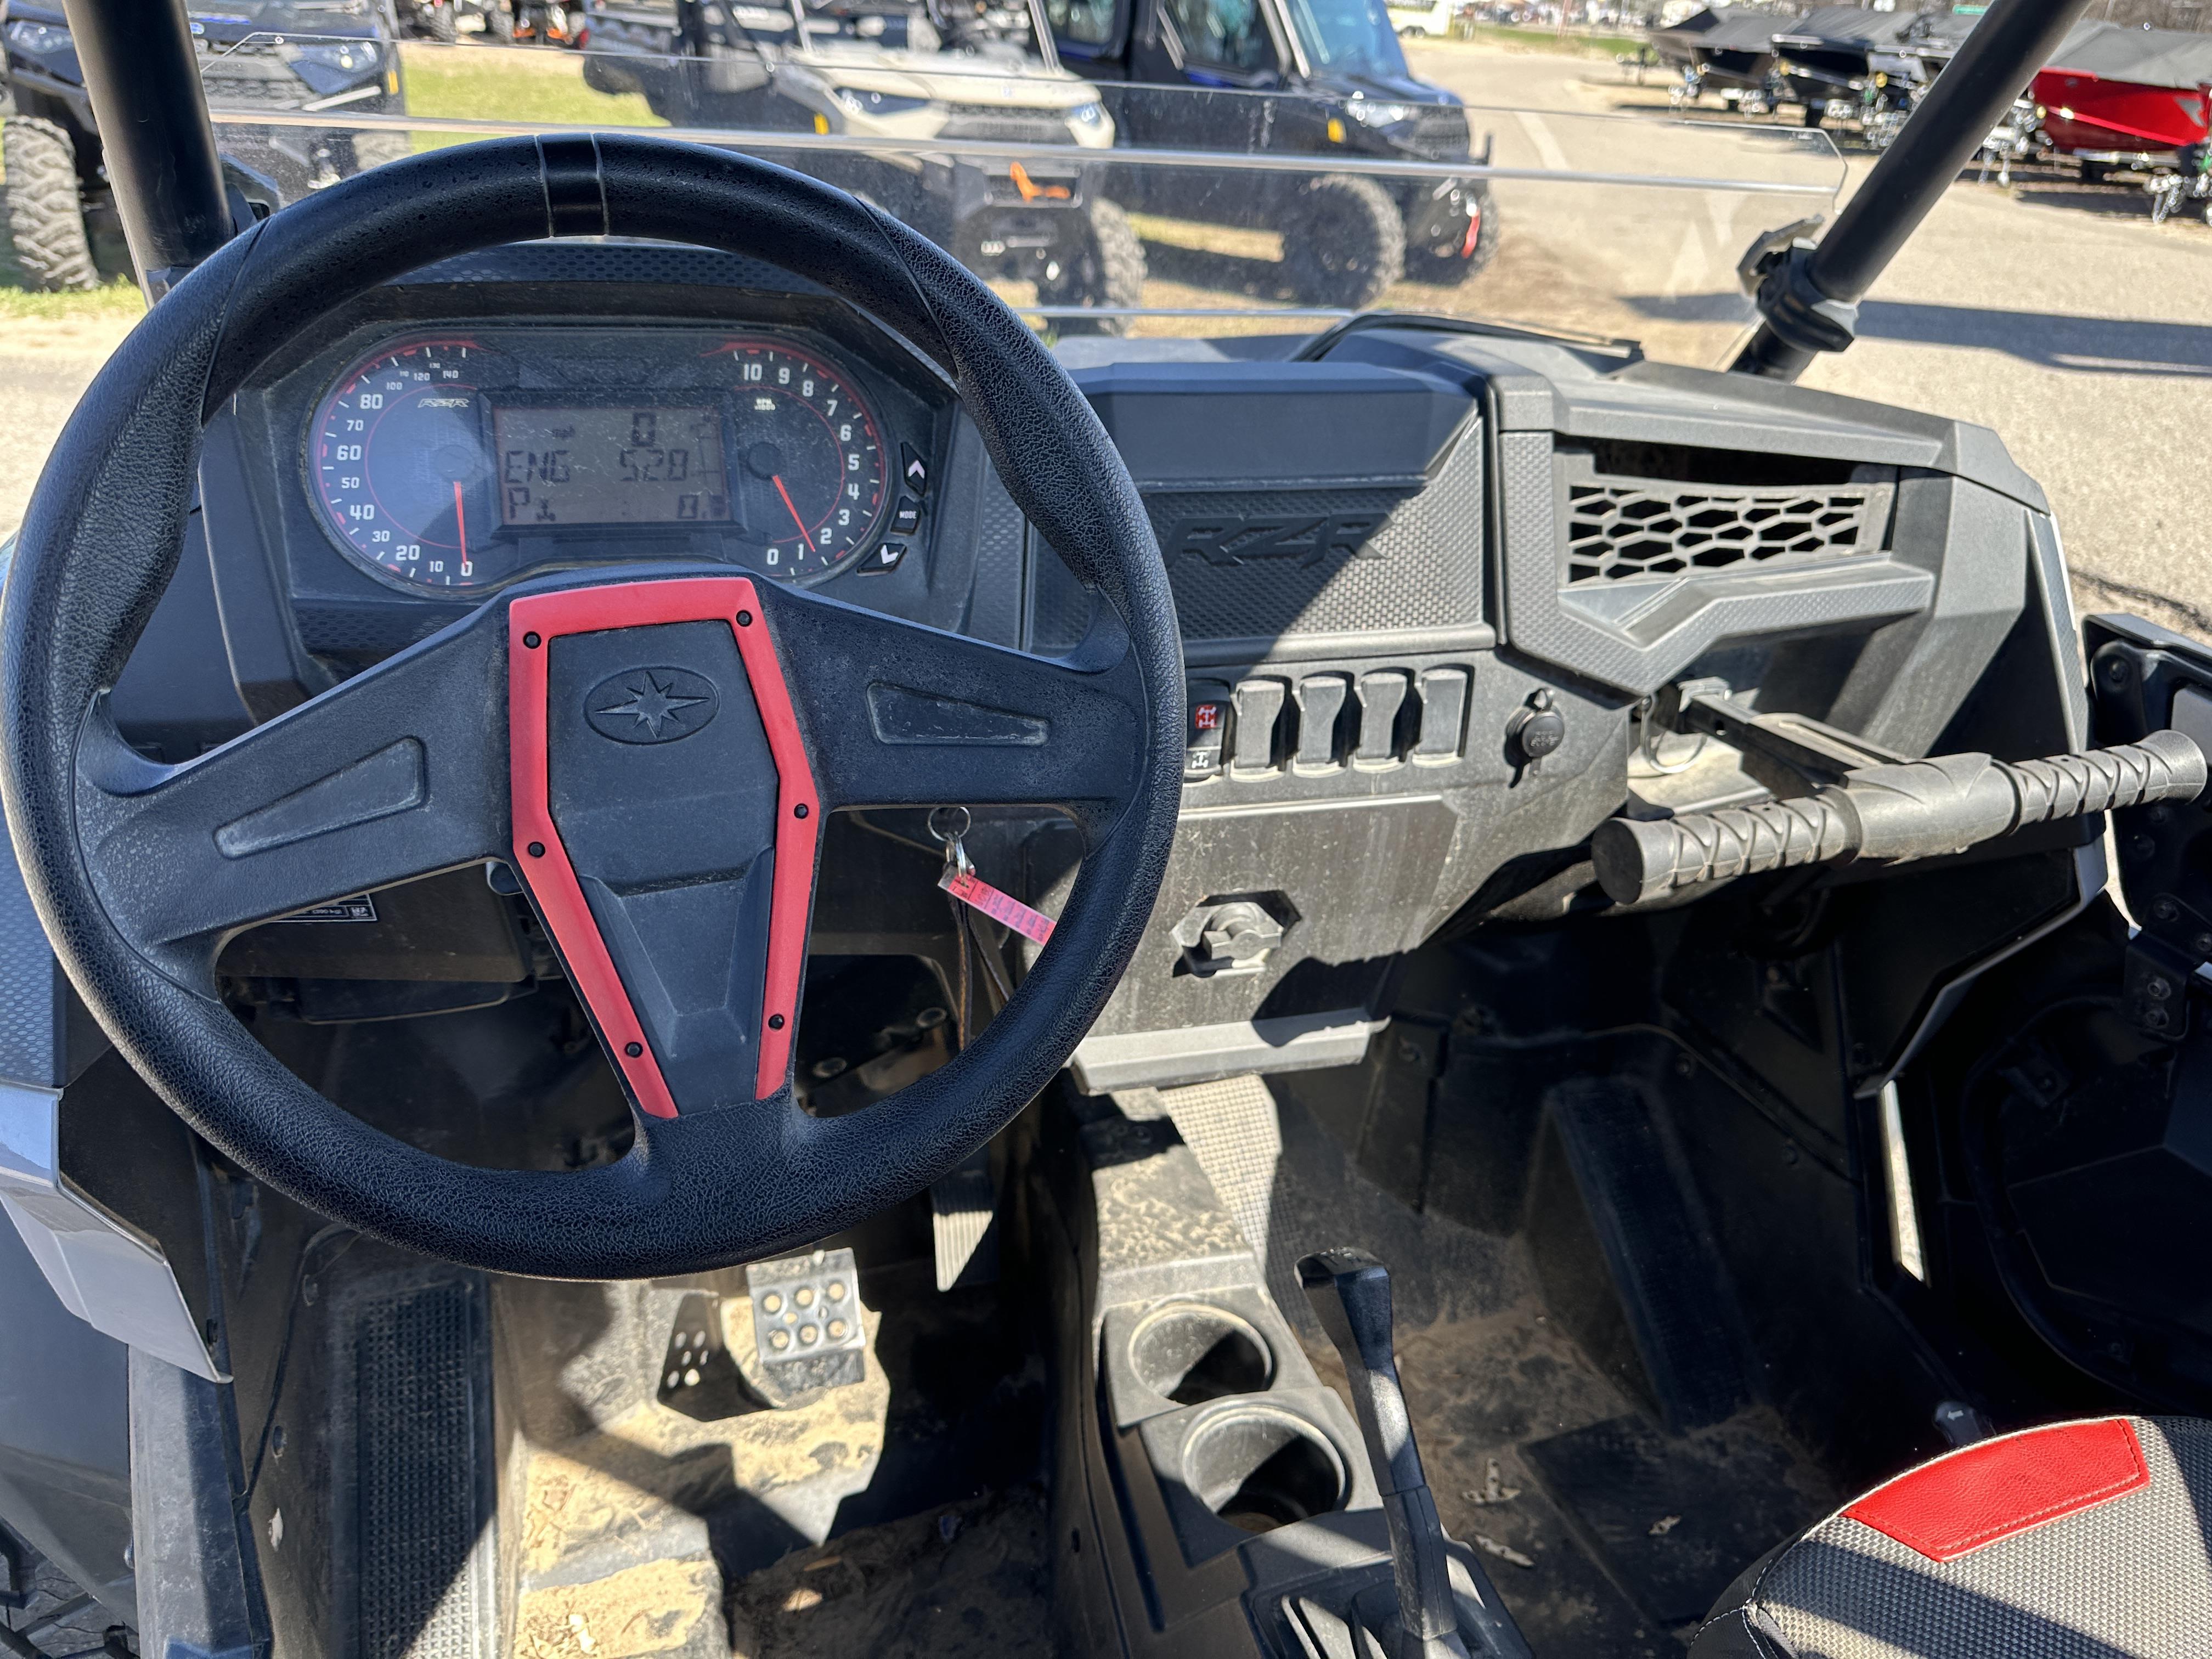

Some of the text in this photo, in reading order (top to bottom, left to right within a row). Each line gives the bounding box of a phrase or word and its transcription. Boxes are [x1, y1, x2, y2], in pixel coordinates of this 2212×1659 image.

[414, 373, 430, 381] 120
[443, 370, 459, 379] 140
[744, 364, 762, 381] 10
[778, 368, 790, 384] 9
[386, 382, 403, 390] 100
[803, 381, 814, 397] 8
[360, 394, 383, 409] 80
[827, 400, 838, 416] 7
[347, 420, 364, 431] 70
[632, 412, 656, 447] 0
[840, 425, 851, 441] 6
[337, 445, 362, 460] 60
[848, 454, 860, 471] 5
[341, 478, 359, 488] 50
[848, 483, 859, 500] 4
[349, 505, 374, 520] 40
[839, 510, 849, 526] 3
[899, 510, 917, 519] MODE
[372, 531, 390, 542] 30
[820, 528, 832, 544] 2
[1161, 510, 1393, 568] RZR
[396, 545, 420, 561] 20
[767, 549, 778, 565] 0
[798, 544, 804, 560] 1
[430, 561, 443, 572] 10
[460, 562, 473, 577] 0
